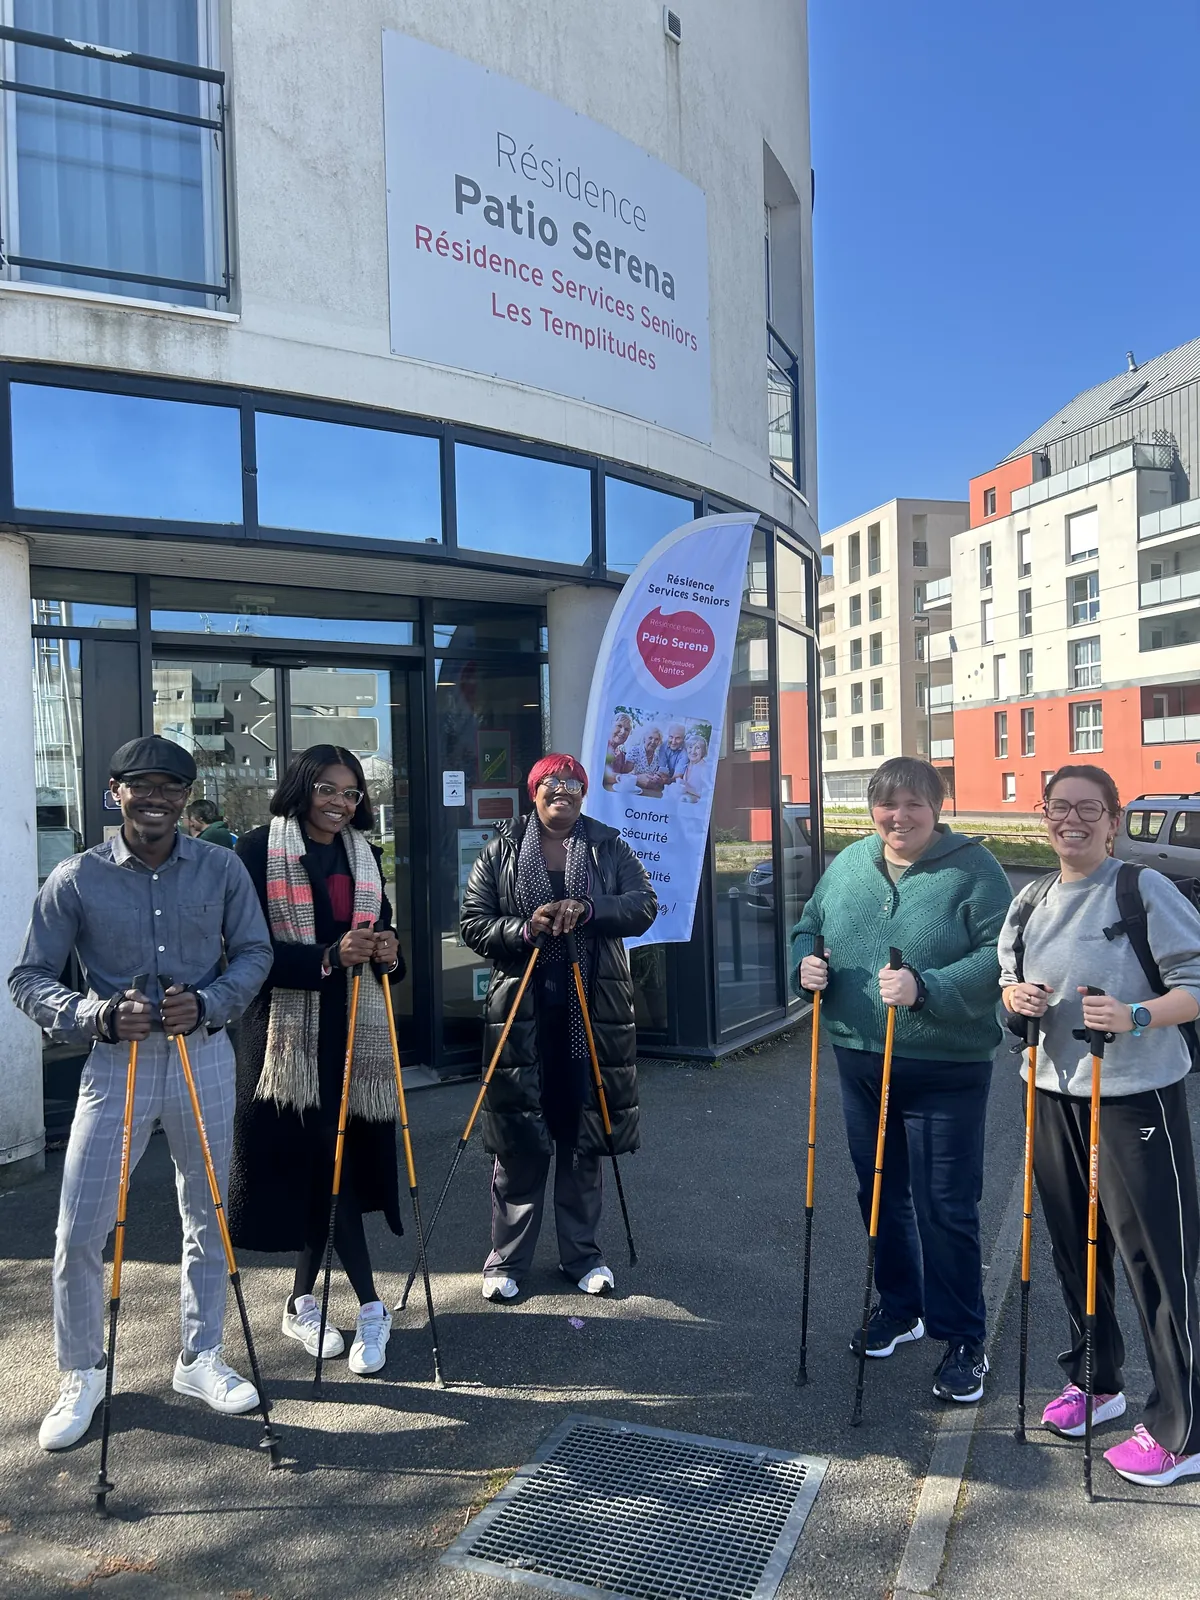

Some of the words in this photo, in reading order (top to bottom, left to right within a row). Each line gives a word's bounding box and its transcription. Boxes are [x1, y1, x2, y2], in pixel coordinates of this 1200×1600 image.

[497, 131, 647, 232] Résidence
[454, 173, 558, 247] Patio
[572, 221, 676, 301] Serena
[415, 224, 544, 287] Résidence
[551, 269, 635, 322] Services
[641, 305, 698, 351] Seniors
[491, 292, 532, 326] Les
[539, 307, 656, 370] Templitudes
[666, 573, 715, 592] Résidence
[648, 583, 689, 600] Services
[692, 592, 730, 607] Seniors
[642, 632, 668, 646] Patio
[671, 637, 709, 653] Serena
[658, 664, 685, 676] Nantes
[624, 808, 669, 824] Confort
[621, 827, 668, 843] Sécurité
